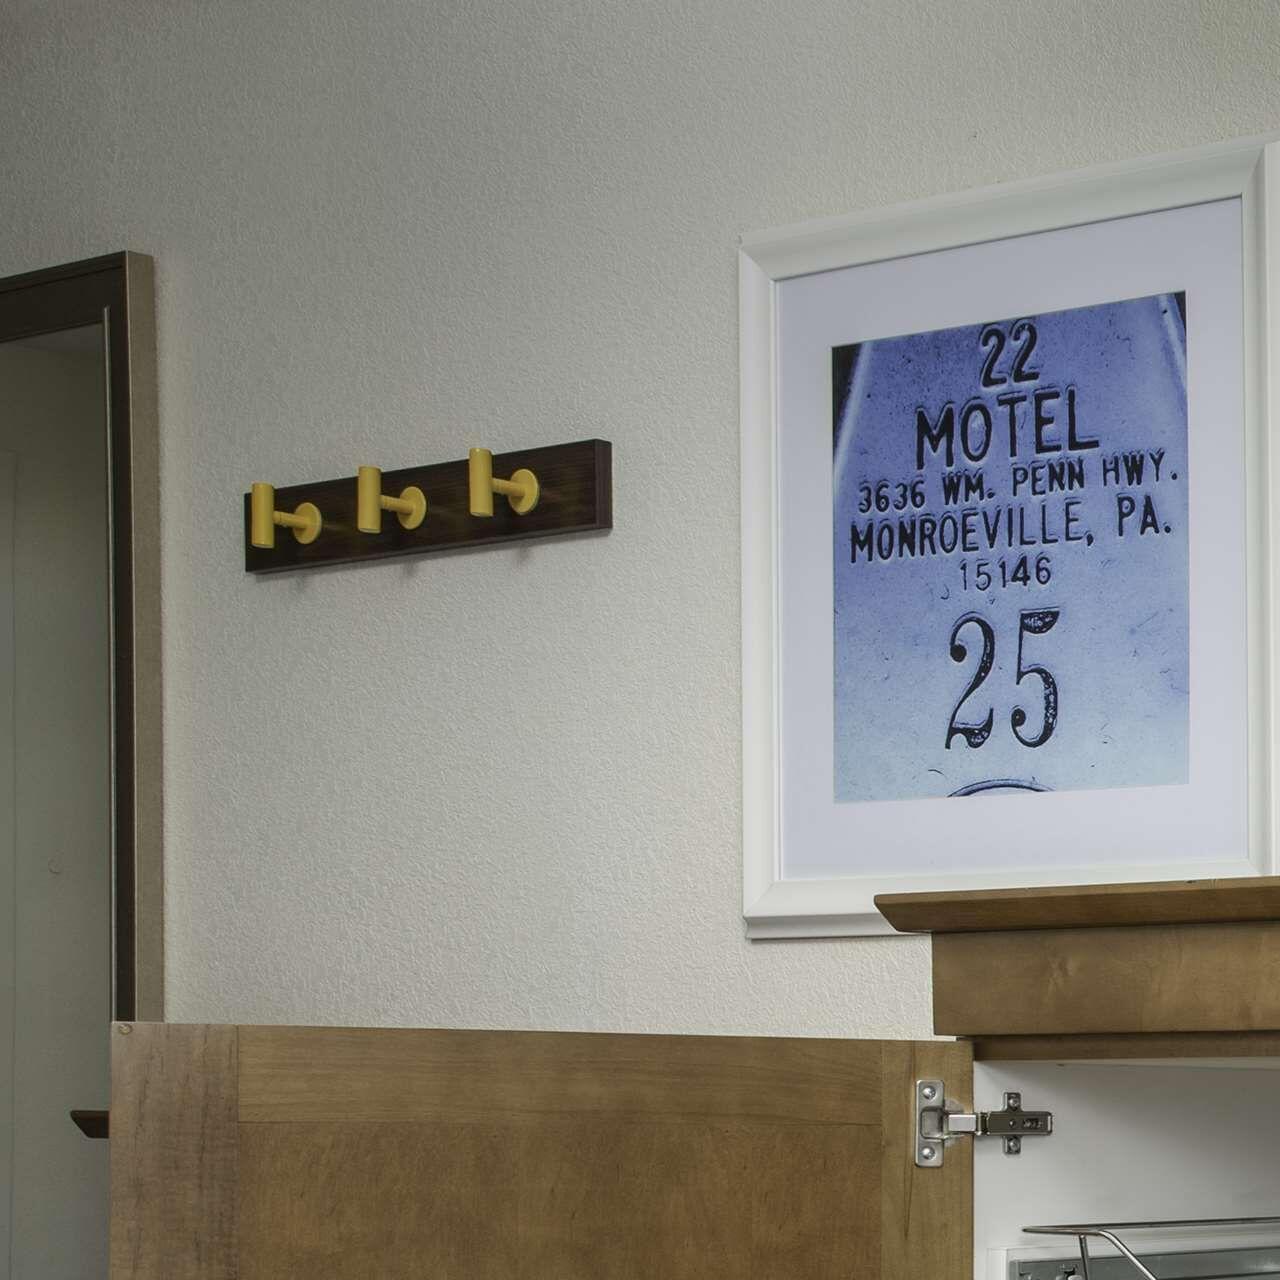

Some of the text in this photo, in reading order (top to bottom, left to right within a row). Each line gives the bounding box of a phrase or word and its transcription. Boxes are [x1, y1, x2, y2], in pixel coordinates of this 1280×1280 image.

[979, 319, 1040, 388] 22
[915, 385, 1099, 470] MOTEL
[858, 448, 1178, 514] 3636 WM. PENN HWY.
[850, 494, 1172, 563] MONROEVILLE, PA.
[959, 551, 1052, 591] 15146
[945, 608, 1060, 749] 25
